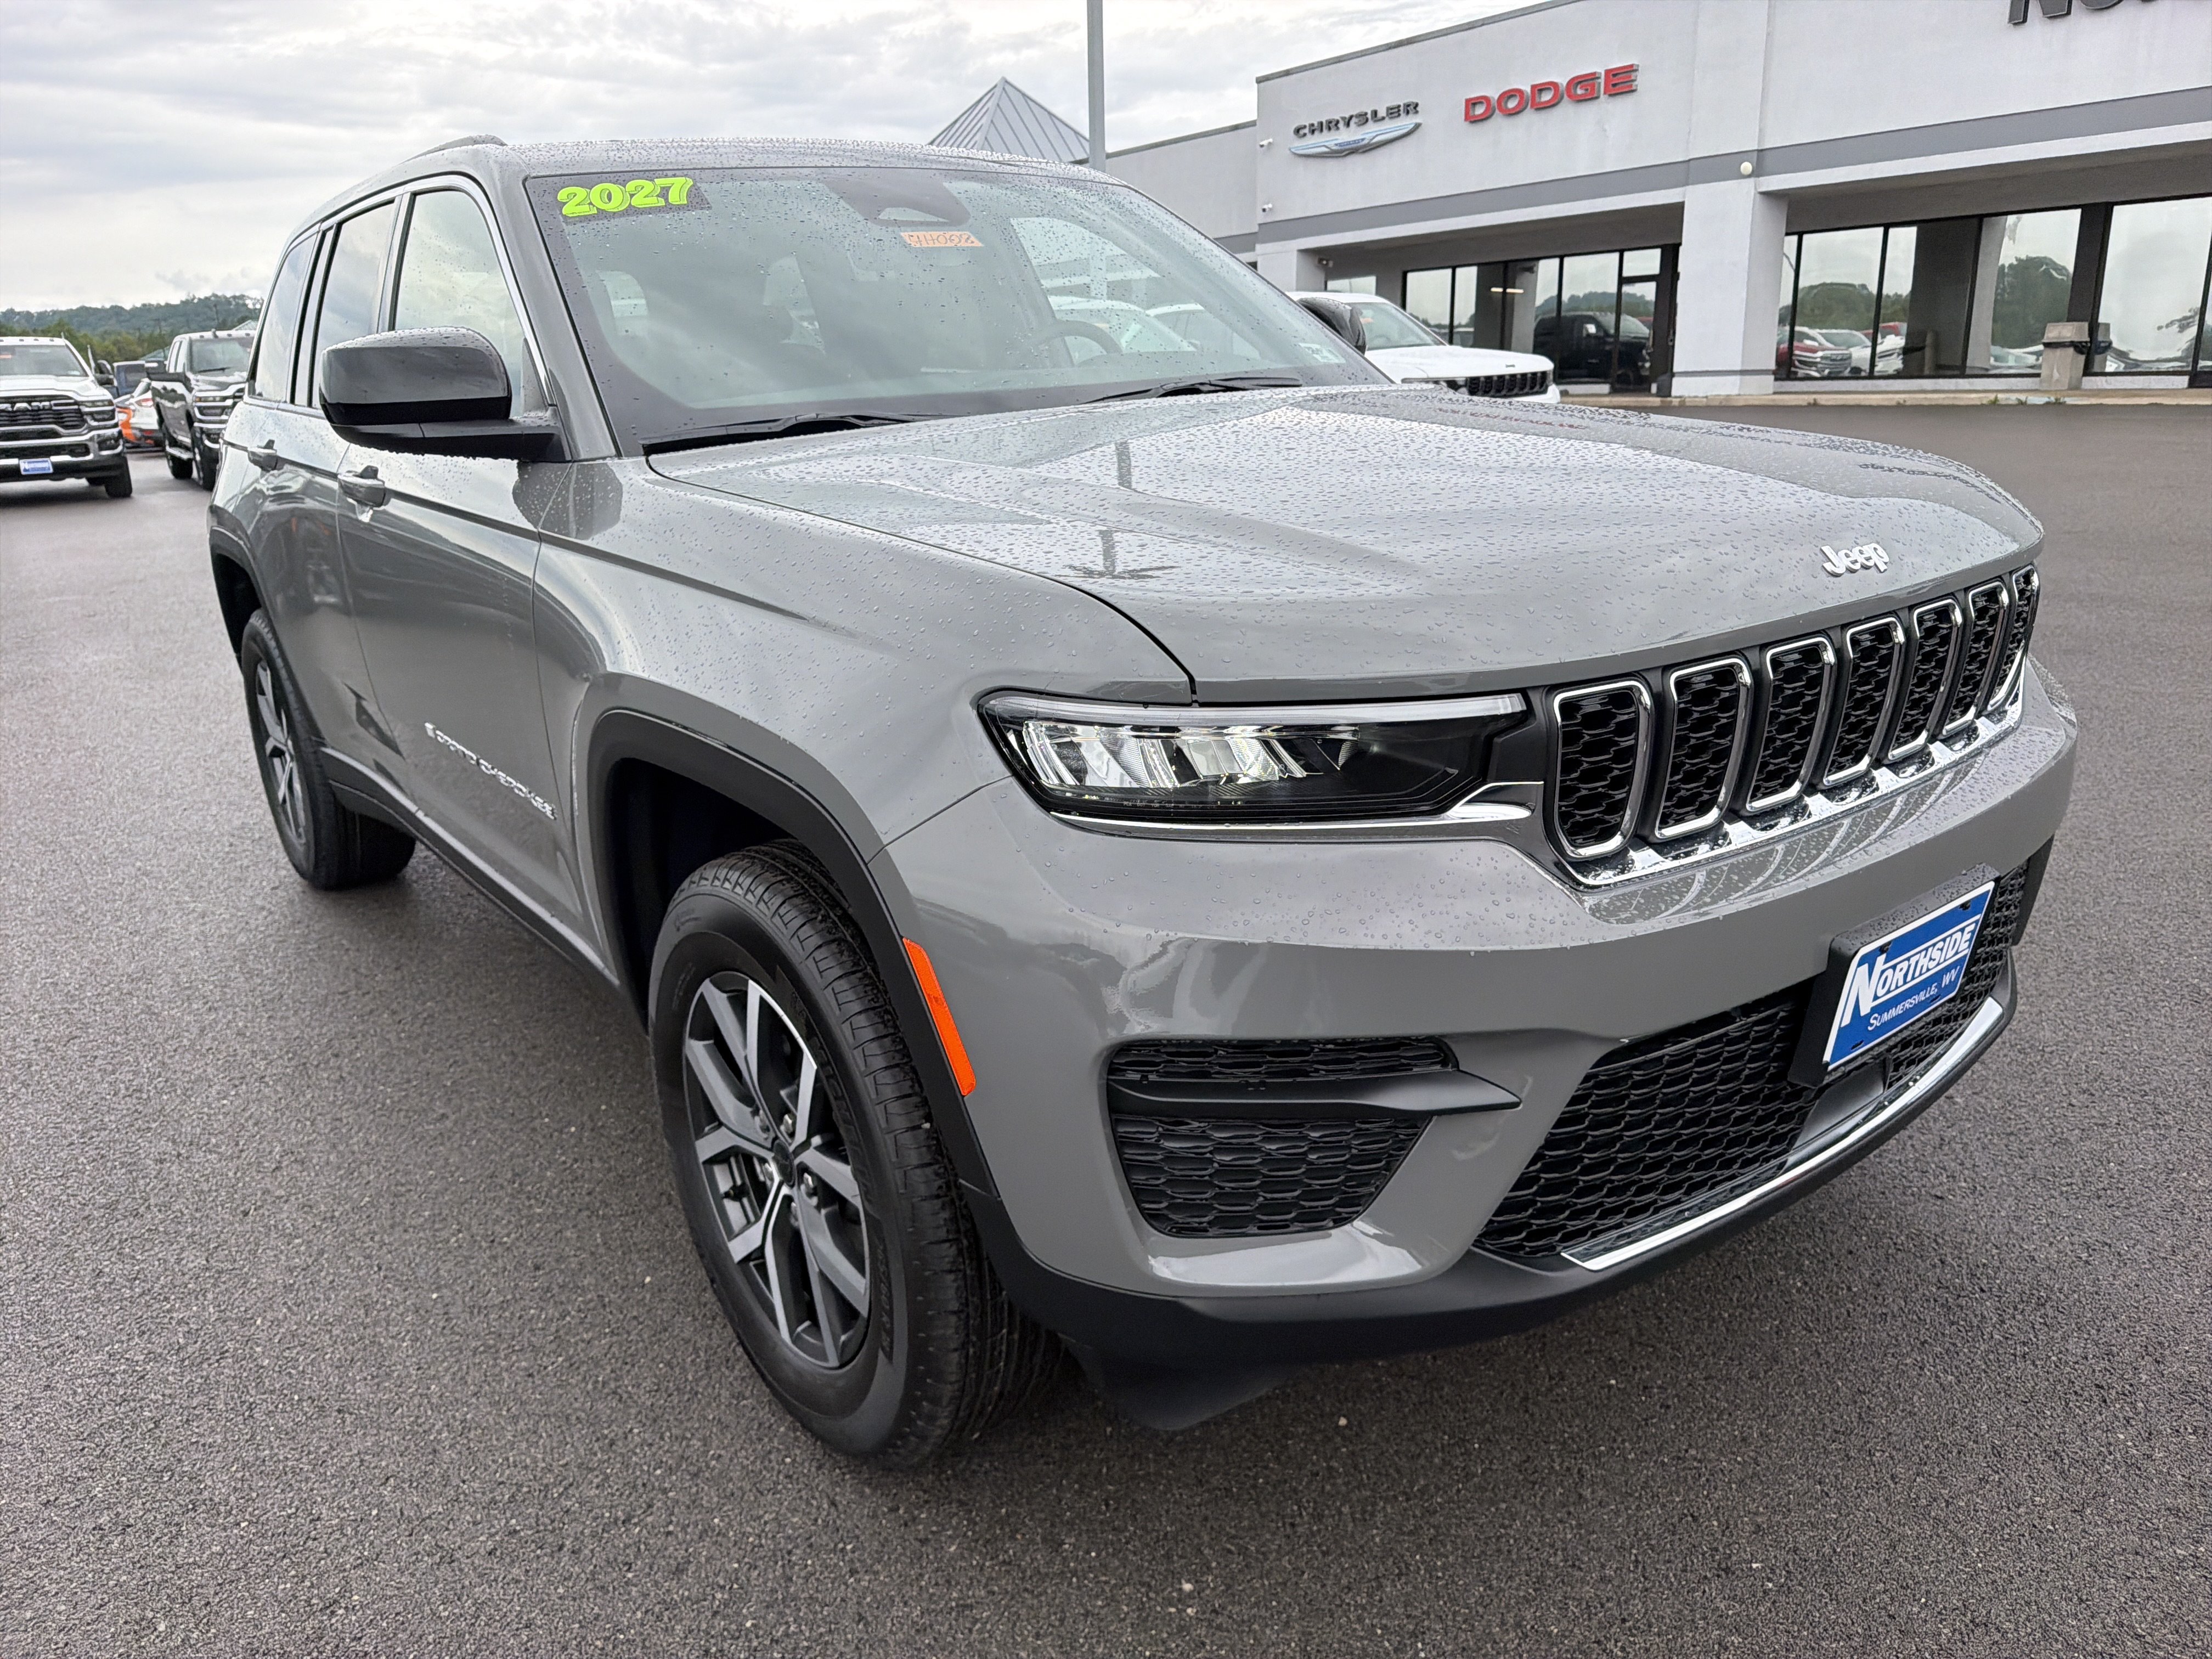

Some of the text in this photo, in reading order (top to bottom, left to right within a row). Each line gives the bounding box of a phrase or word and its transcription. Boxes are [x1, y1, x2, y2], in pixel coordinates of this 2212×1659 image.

[1464, 62, 1639, 123] DODGE
[1293, 100, 1420, 139] CHRYSLER
[557, 176, 693, 217] 2027
[1820, 543, 1890, 577] Jeep
[1841, 923, 1975, 1028] NORTHSIDE
[1867, 966, 1960, 1031] SUMMERSVILLE, WV
